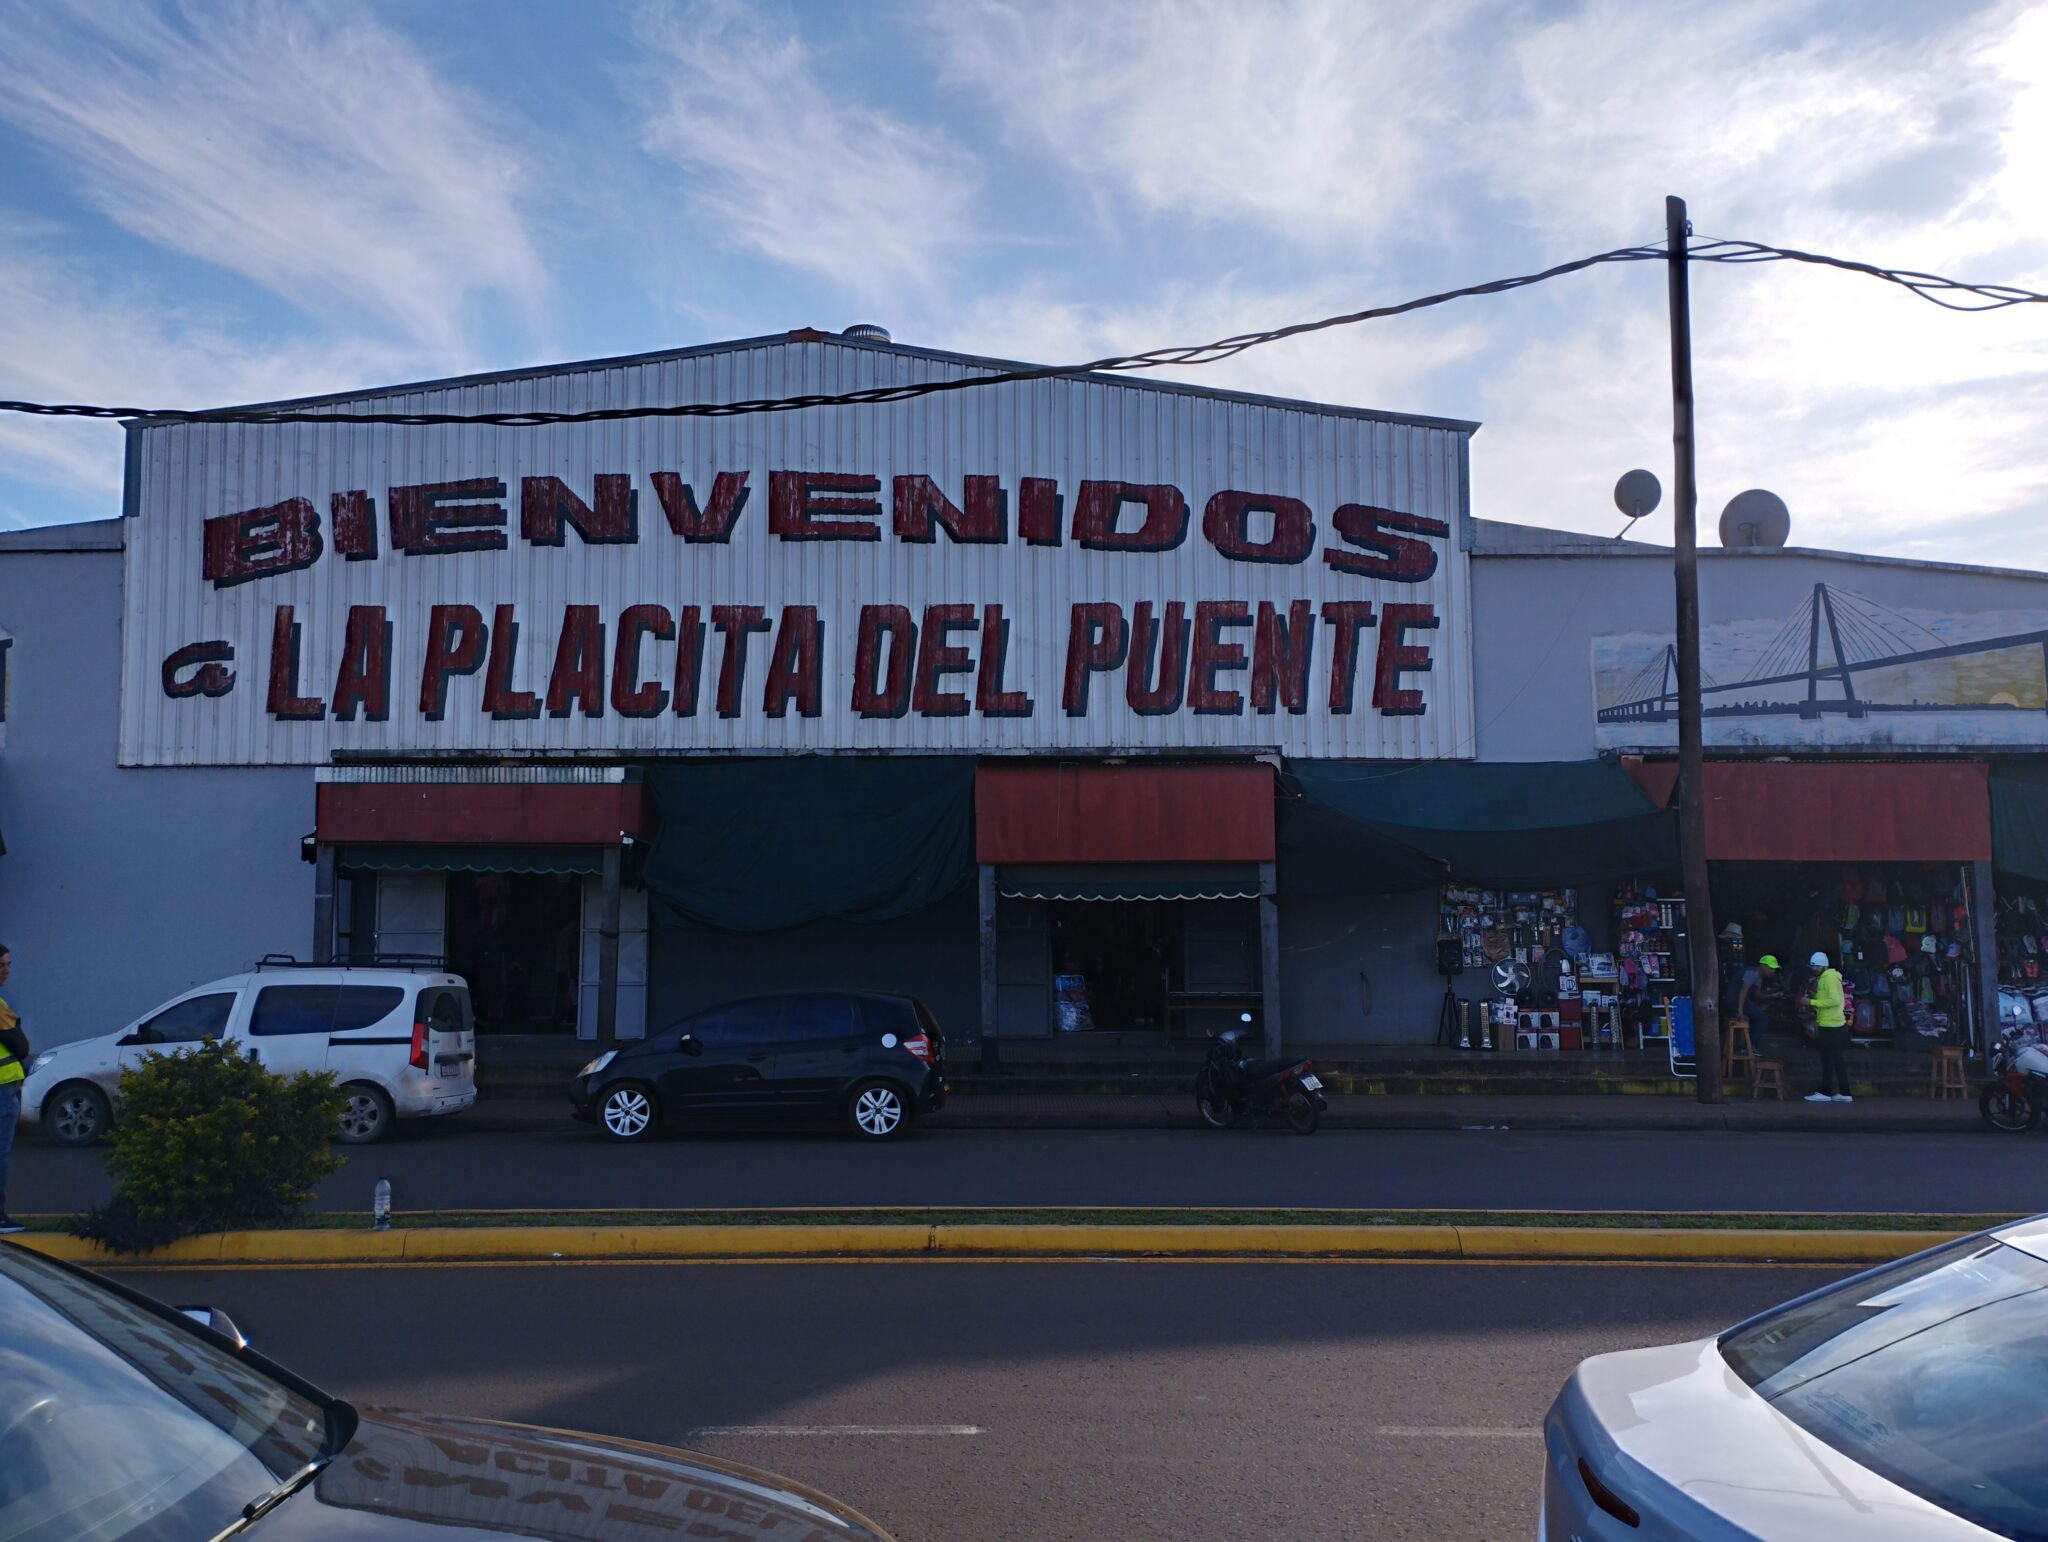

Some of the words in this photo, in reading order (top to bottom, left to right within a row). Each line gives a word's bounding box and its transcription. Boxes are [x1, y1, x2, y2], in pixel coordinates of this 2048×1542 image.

[202, 471, 1449, 589] BIENVENIDOS
[162, 640, 236, 699] a
[266, 604, 394, 721] LA
[419, 603, 825, 721] PLACITA
[851, 603, 1034, 719] DEL
[1062, 600, 1440, 717] PUENTE
